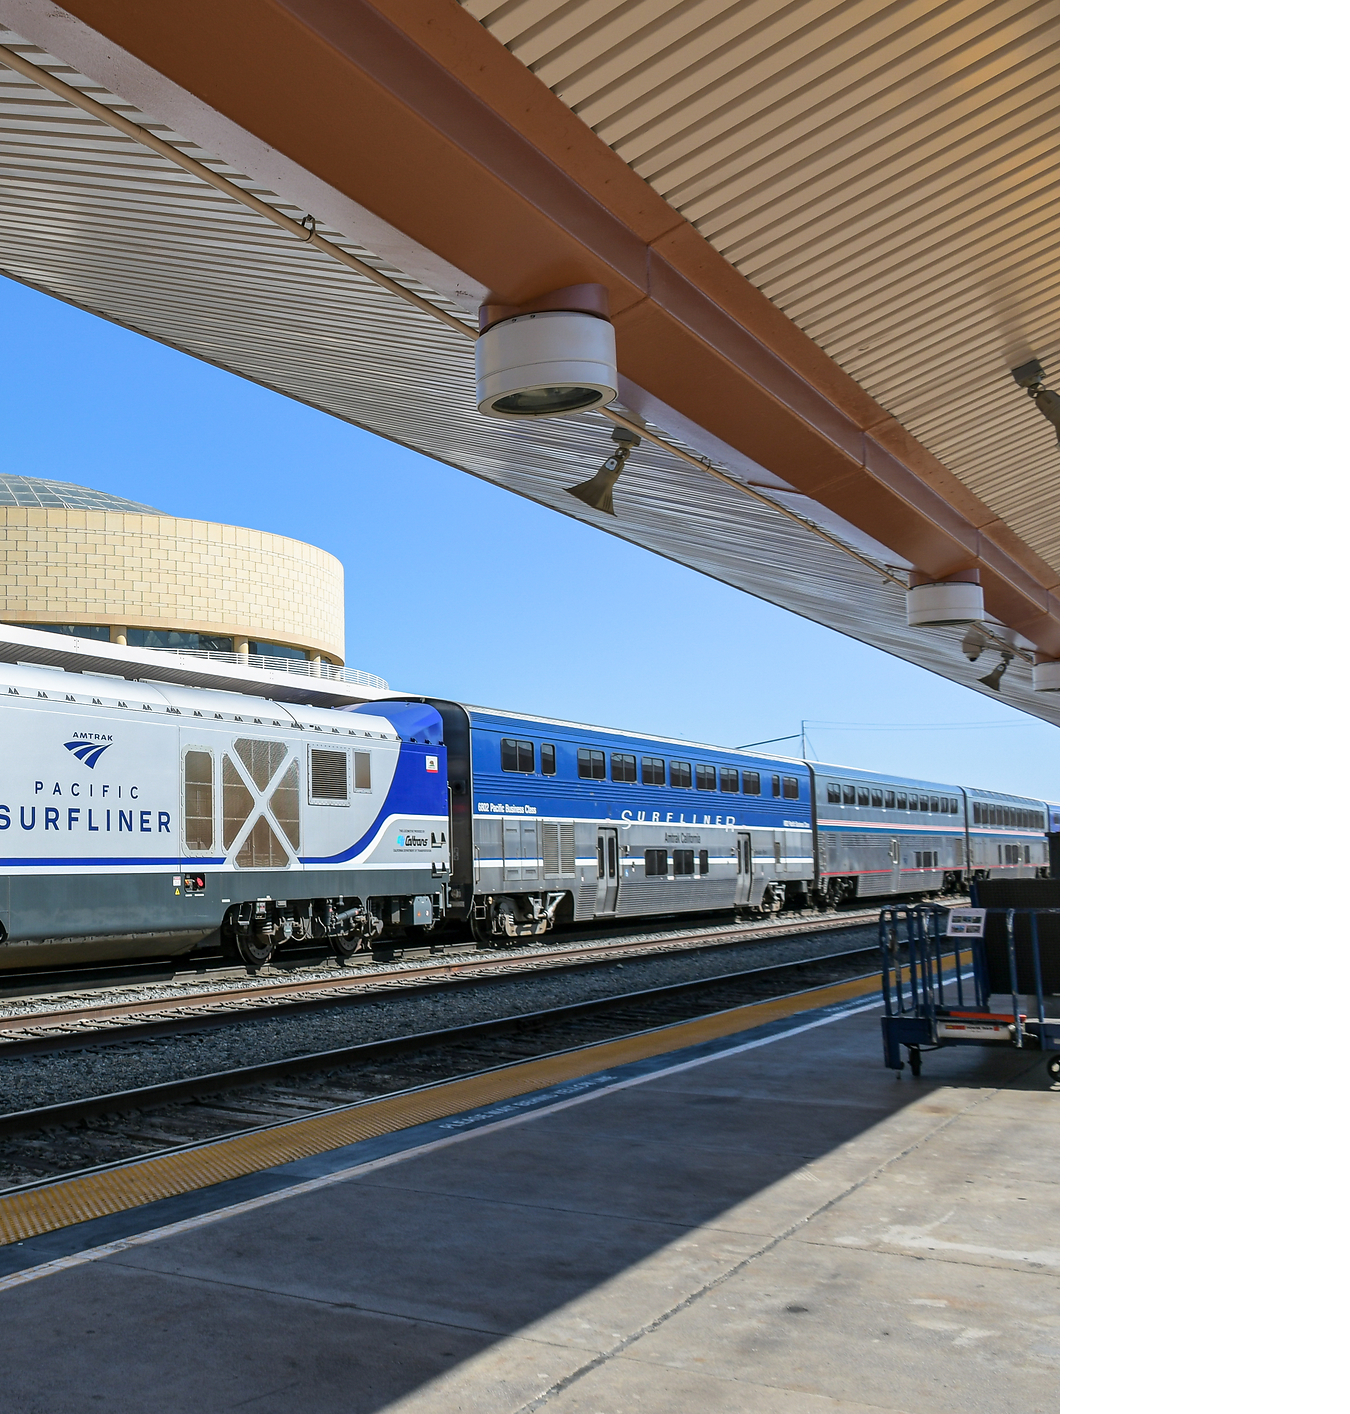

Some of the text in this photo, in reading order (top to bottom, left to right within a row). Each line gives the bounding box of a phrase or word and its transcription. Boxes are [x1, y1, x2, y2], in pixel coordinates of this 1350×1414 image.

[72, 731, 113, 741] AMTRAK
[34, 780, 139, 799] PACIFIC
[621, 809, 736, 833] SURFLINER
[405, 835, 429, 846] Caltrans
